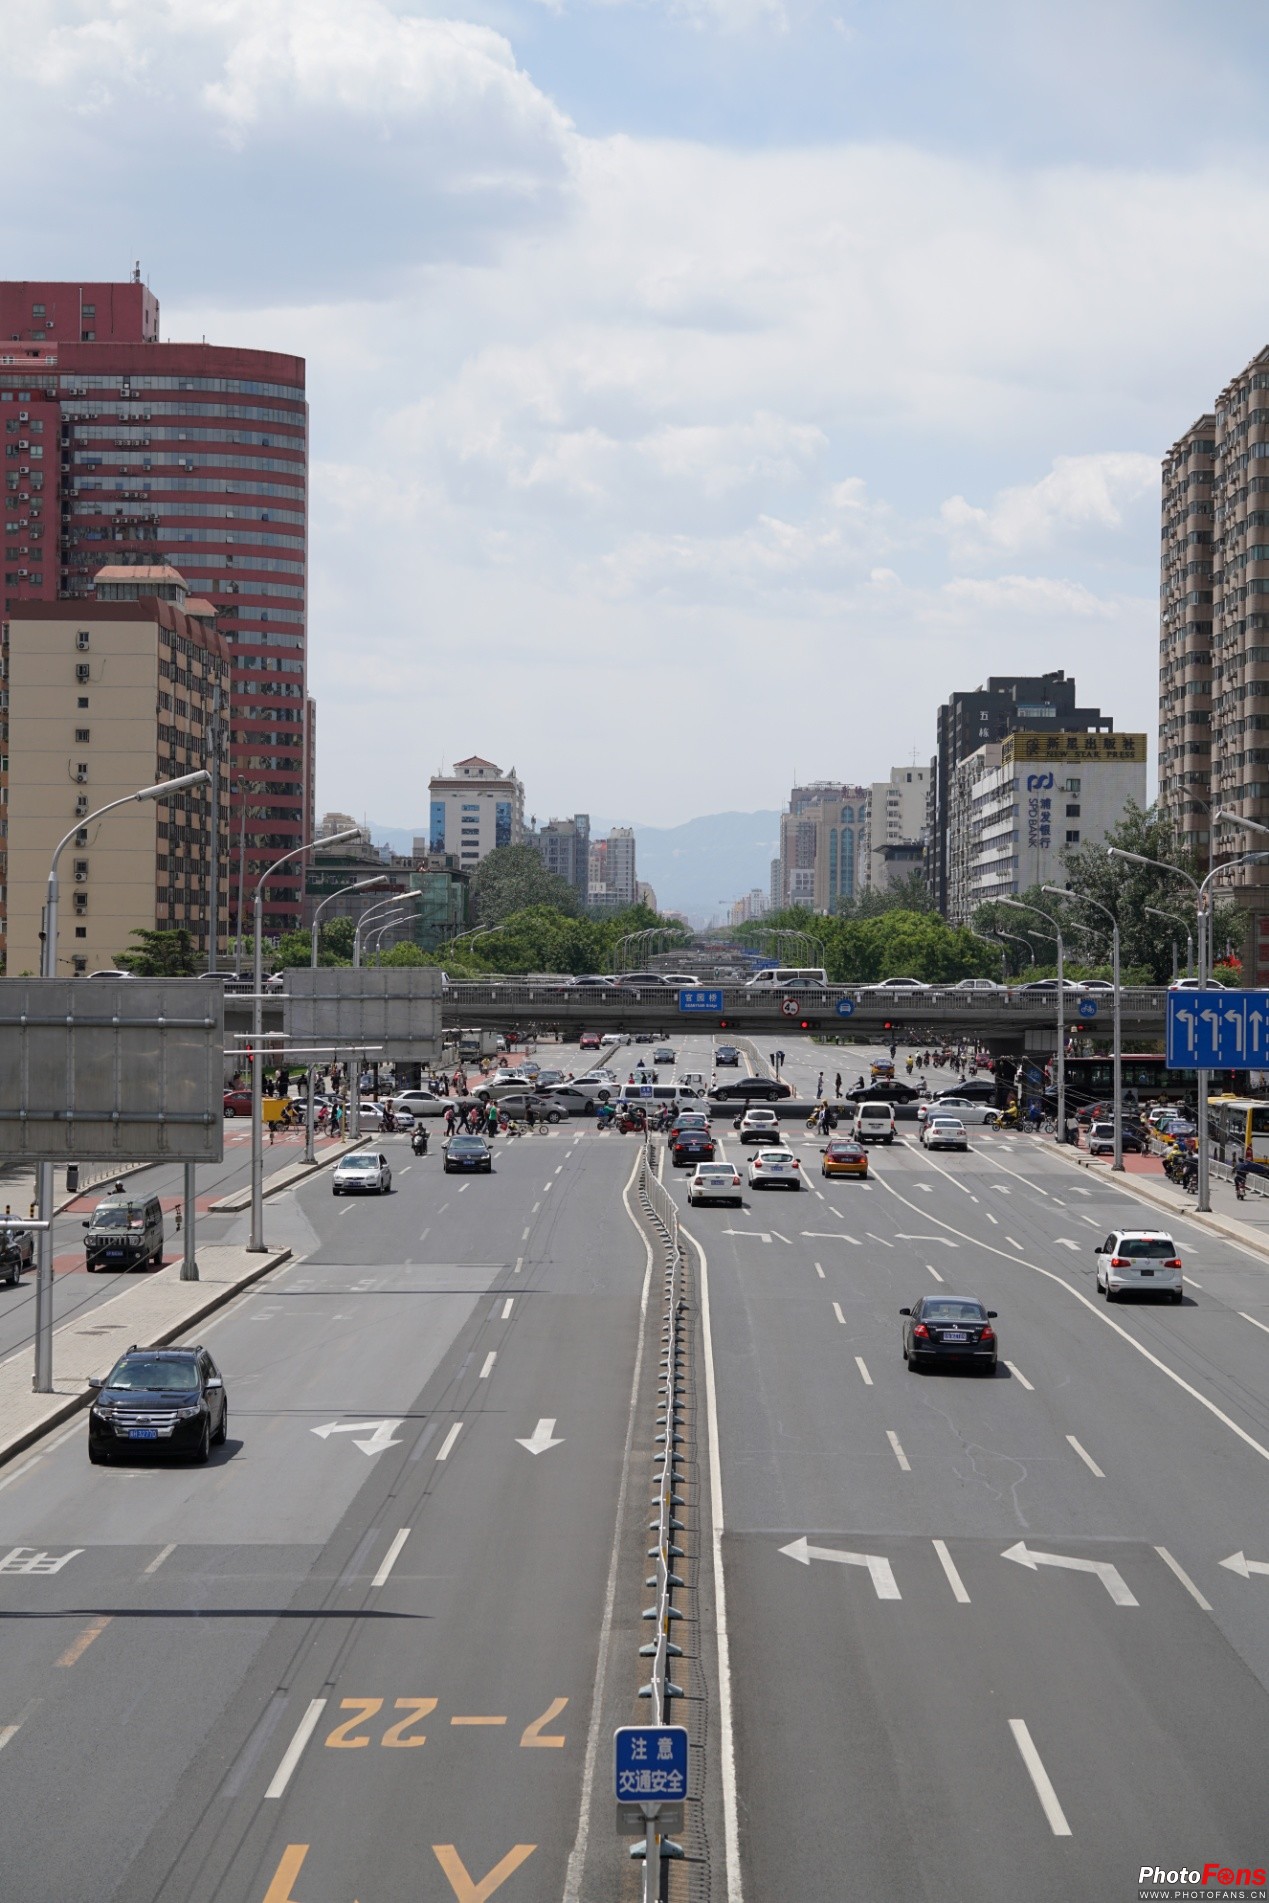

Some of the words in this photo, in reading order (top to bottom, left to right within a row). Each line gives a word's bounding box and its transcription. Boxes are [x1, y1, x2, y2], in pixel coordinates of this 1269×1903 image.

[1046, 737, 1136, 751] 新星出版社
[1106, 751, 1136, 759] PRESS
[1028, 798, 1039, 816] SPD
[1028, 819, 1039, 848] BANK
[1040, 797, 1052, 849] 浦发银行
[631, 1737, 673, 1760] 注意
[619, 1769, 684, 1793] 交通安全
